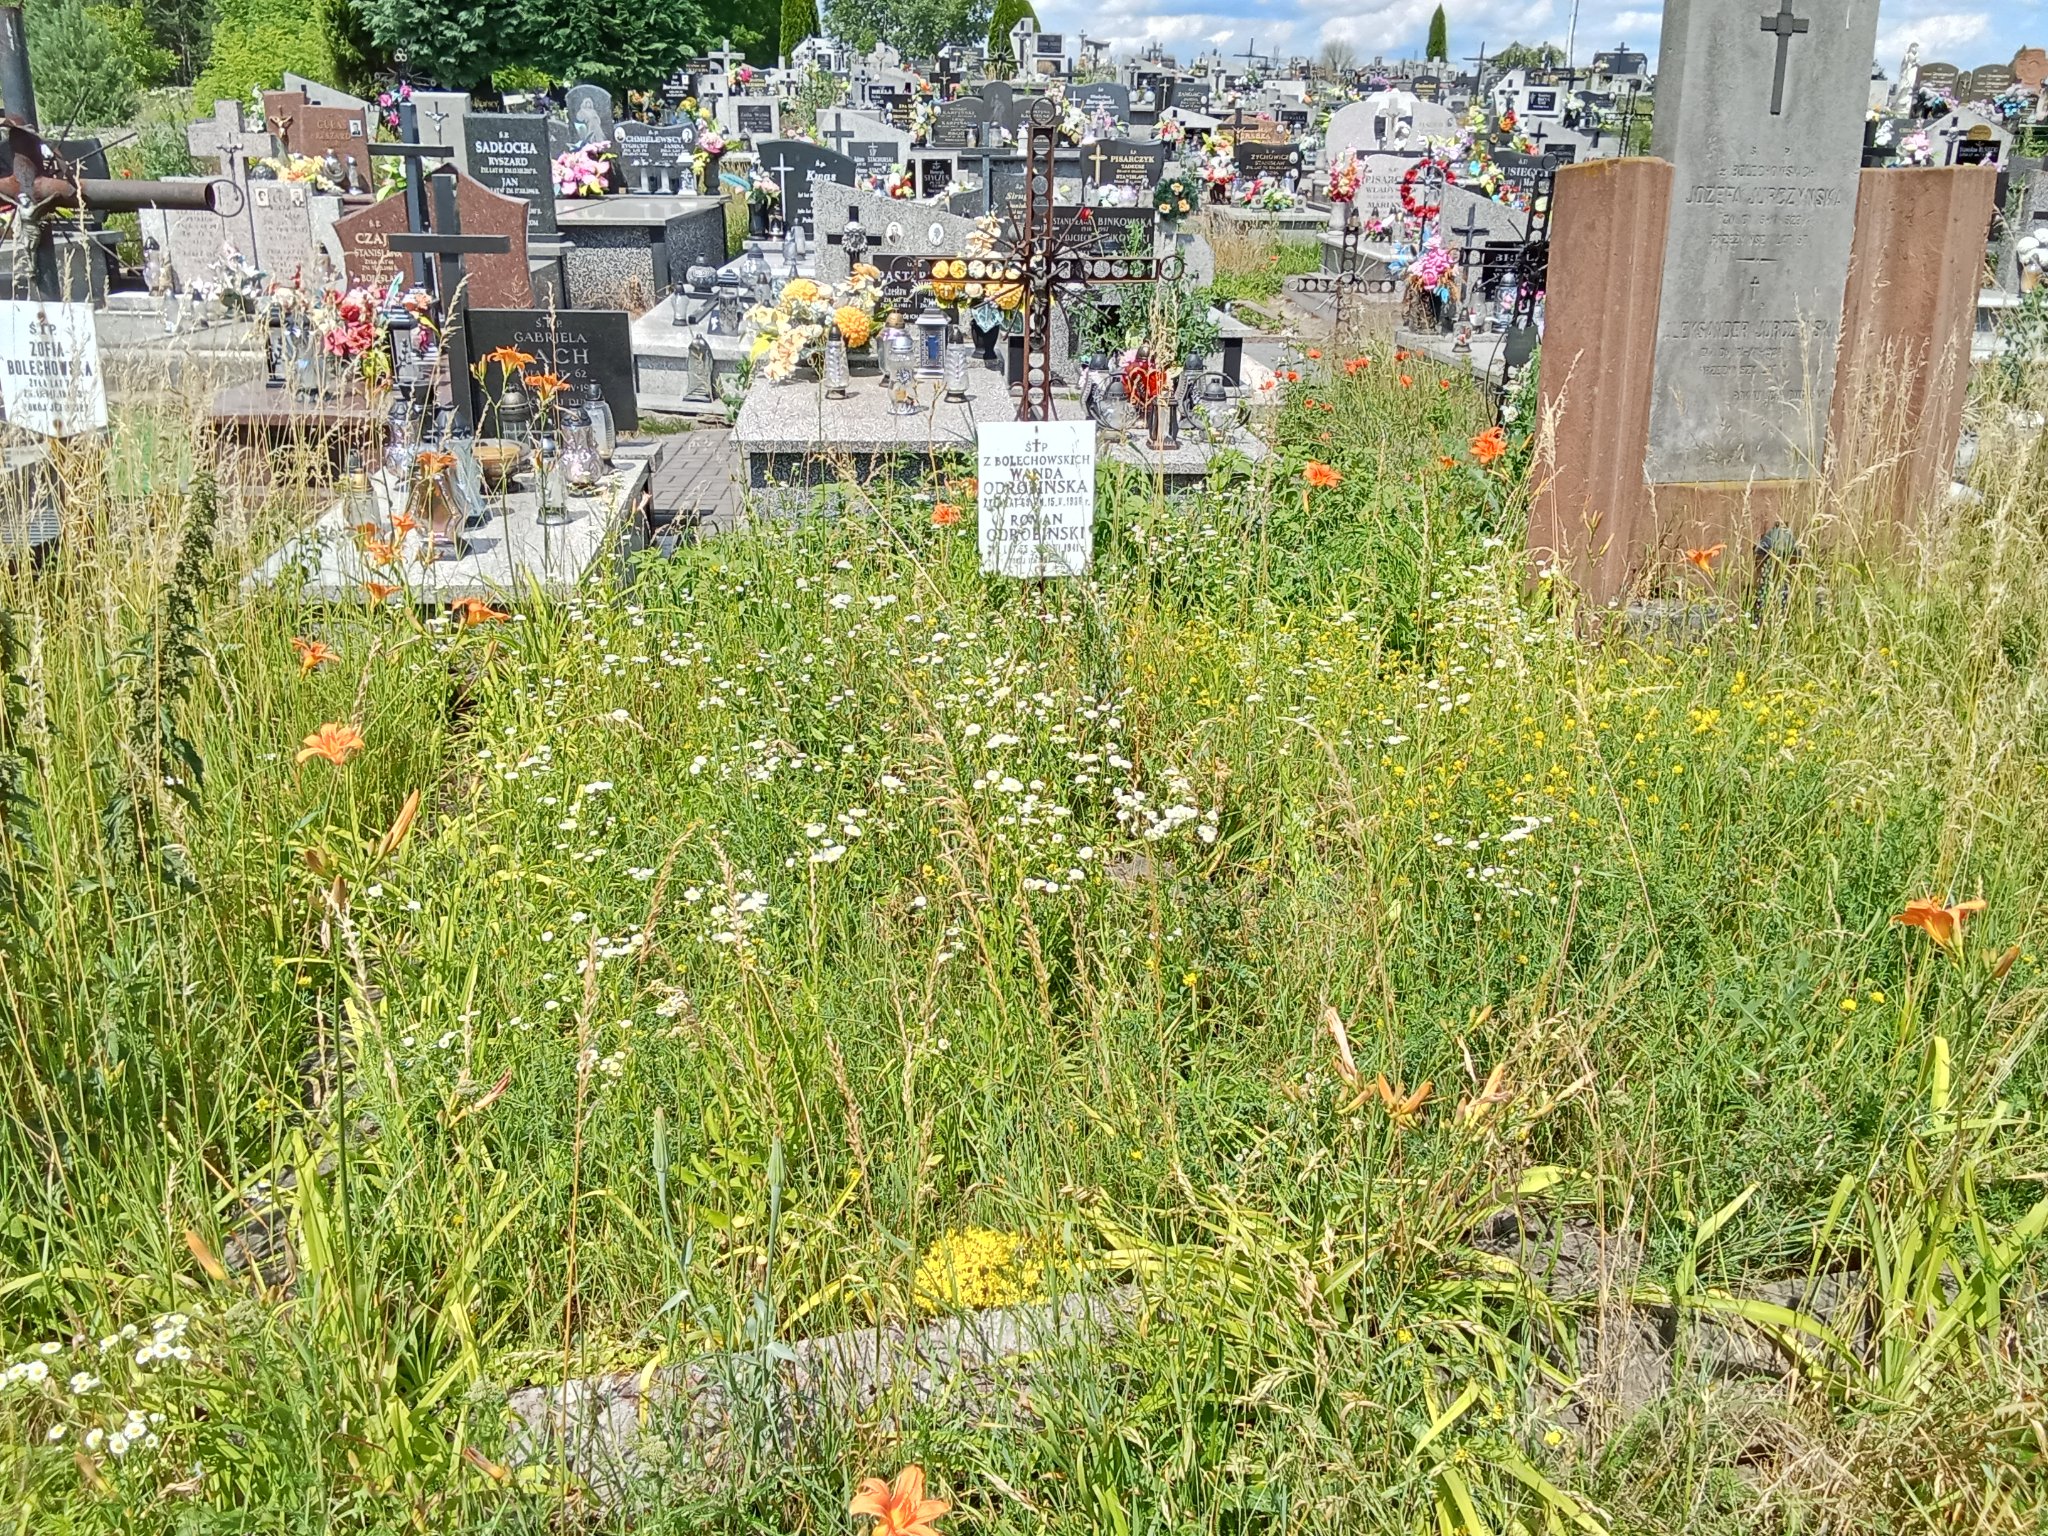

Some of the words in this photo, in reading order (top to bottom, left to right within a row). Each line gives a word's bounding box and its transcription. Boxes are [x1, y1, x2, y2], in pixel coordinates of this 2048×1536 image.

[475, 140, 538, 154] SADŁOCHA
[487, 156, 528, 167] RYSZARD
[1110, 155, 1155, 163] PISARCZYK
[501, 177, 519, 188] JAN
[513, 331, 588, 344] GABRIELA
[28, 341, 65, 358] ZOFIA
[574, 369, 588, 378] 62
[983, 456, 992, 467] Z
[994, 454, 1091, 467] BOLECHOWSKICH
[1009, 467, 1064, 481] WANDA
